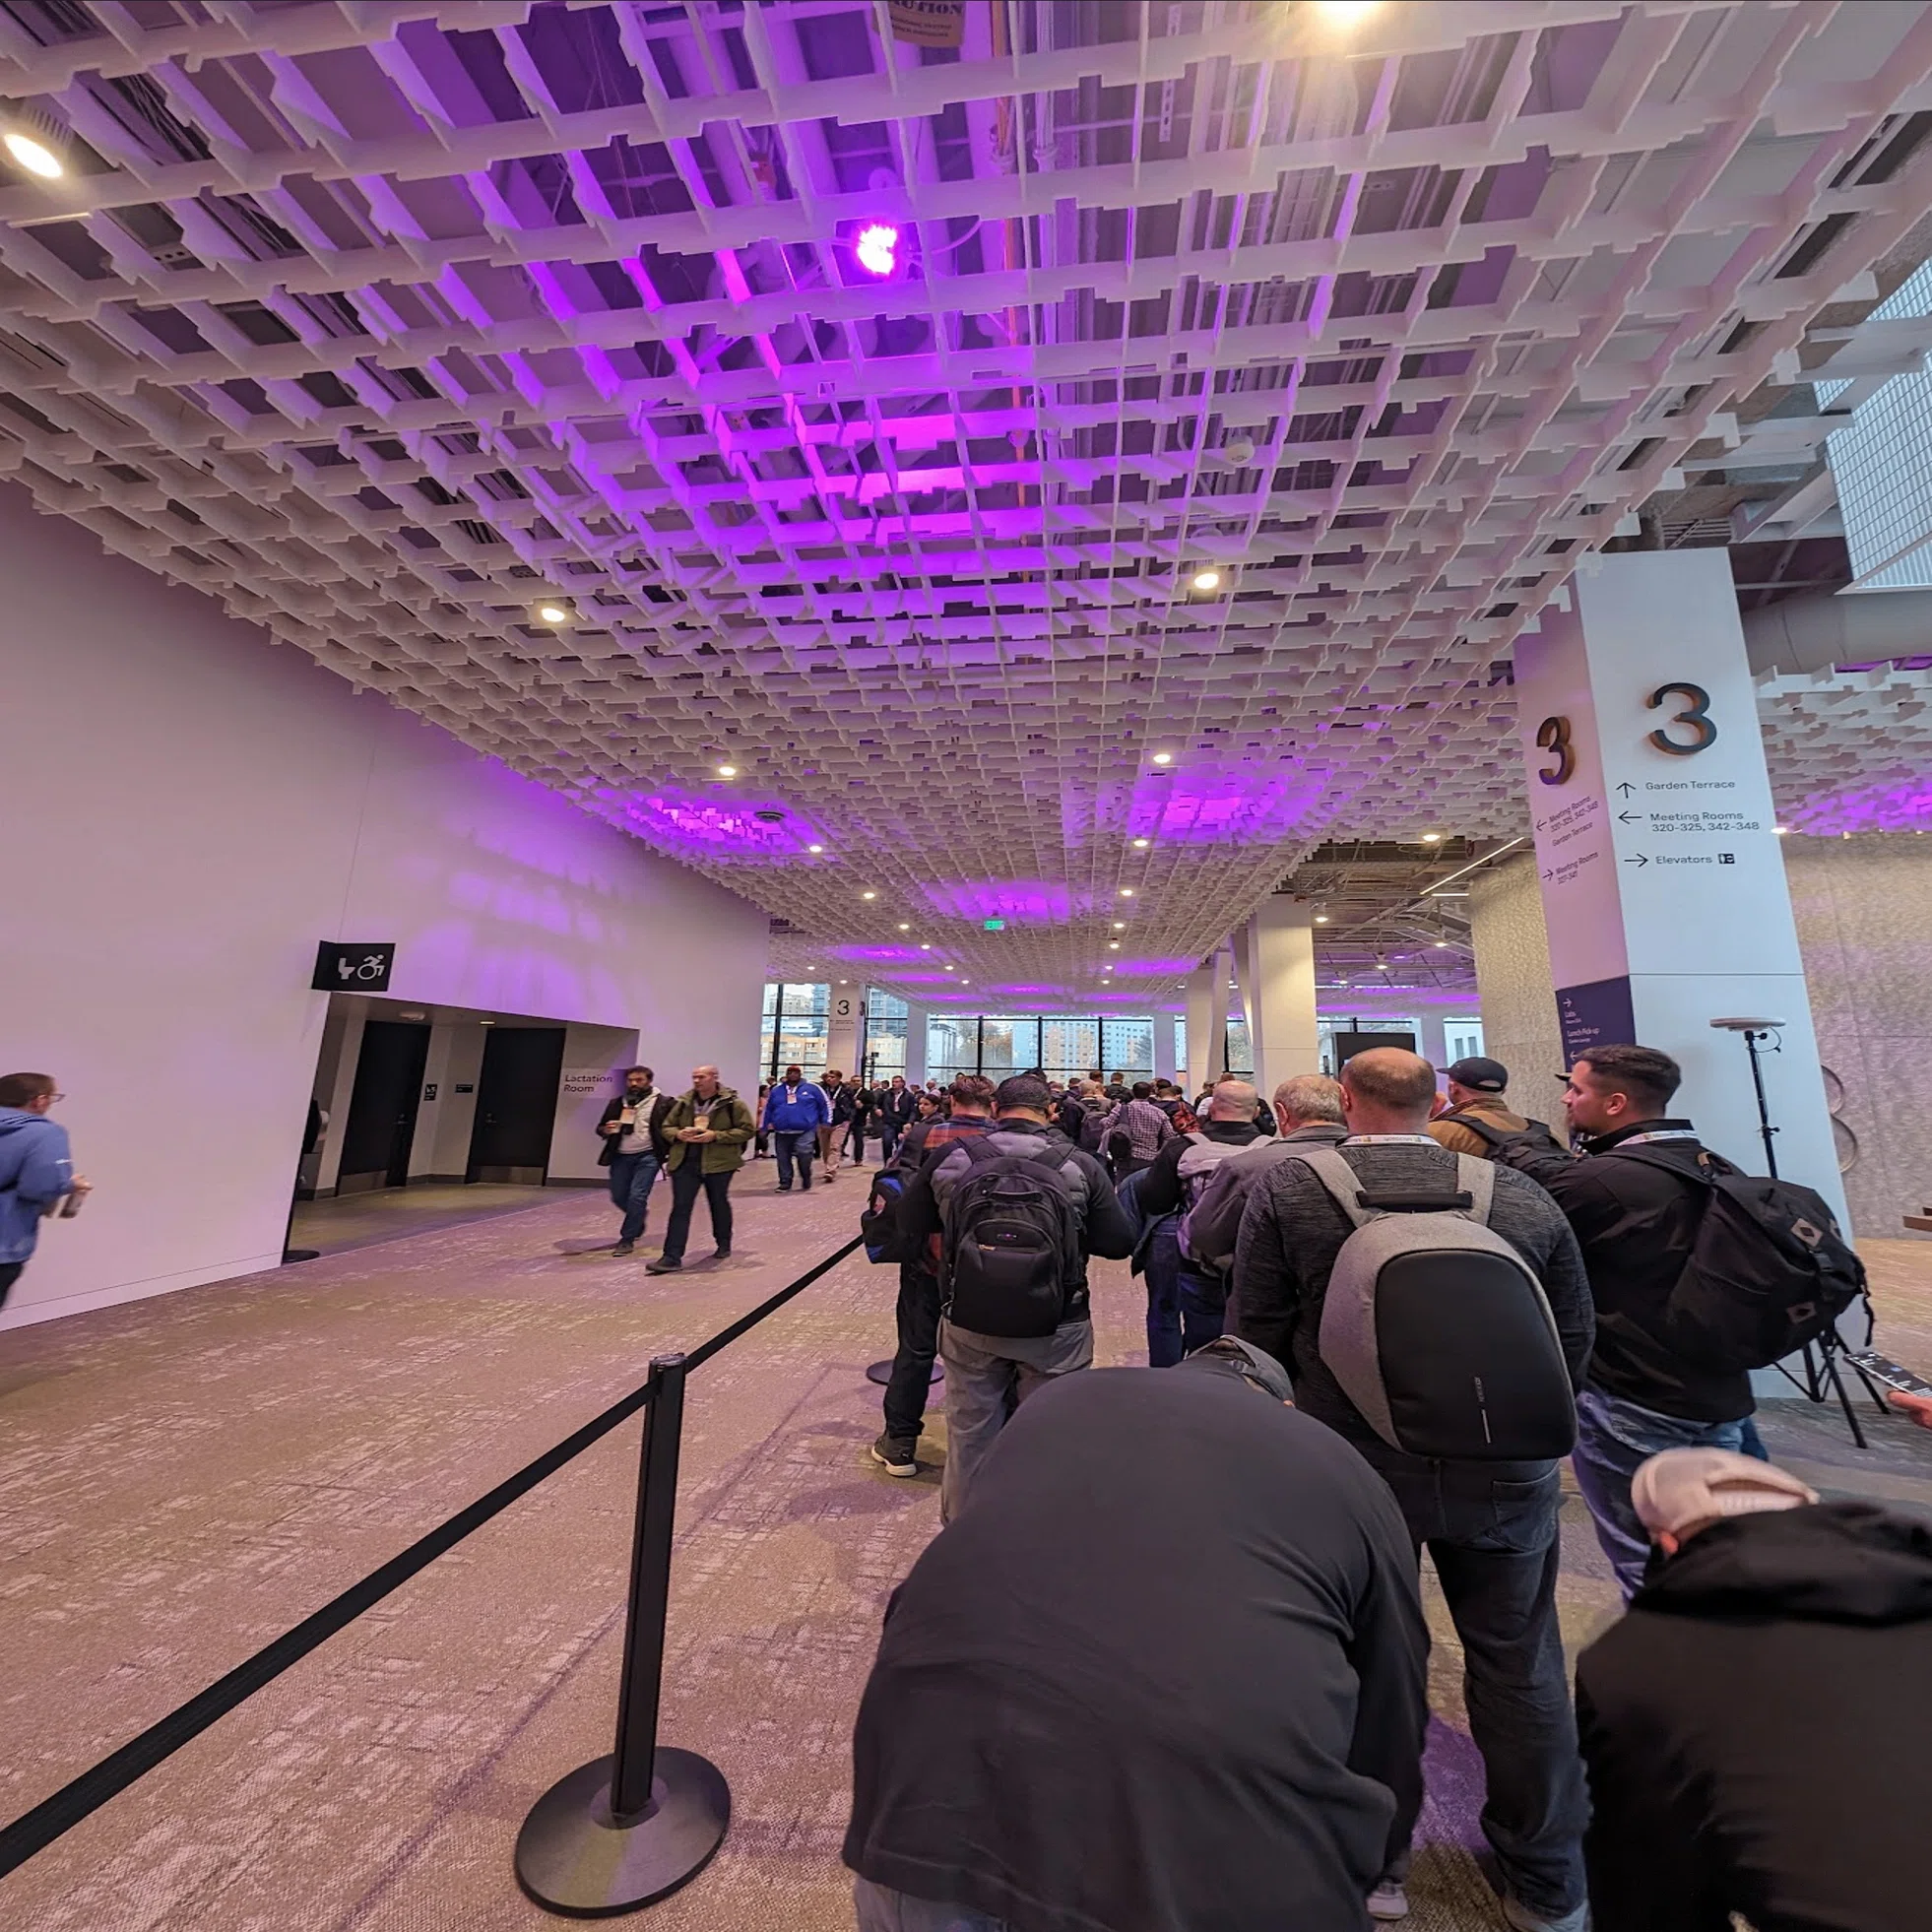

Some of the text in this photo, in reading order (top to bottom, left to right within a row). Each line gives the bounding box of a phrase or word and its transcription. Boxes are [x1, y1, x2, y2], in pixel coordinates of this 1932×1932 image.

[892, 0, 962, 14] UTION
[1647, 681, 1717, 755] 3
[1537, 716, 1576, 786] 3
[1645, 780, 1736, 791] Garden Terrace
[1650, 811, 1744, 822] Meeting Rooms
[1652, 821, 1760, 832] 320-325, 342-348
[1655, 855, 1712, 865] Elevators
[837, 999, 850, 1015] 3
